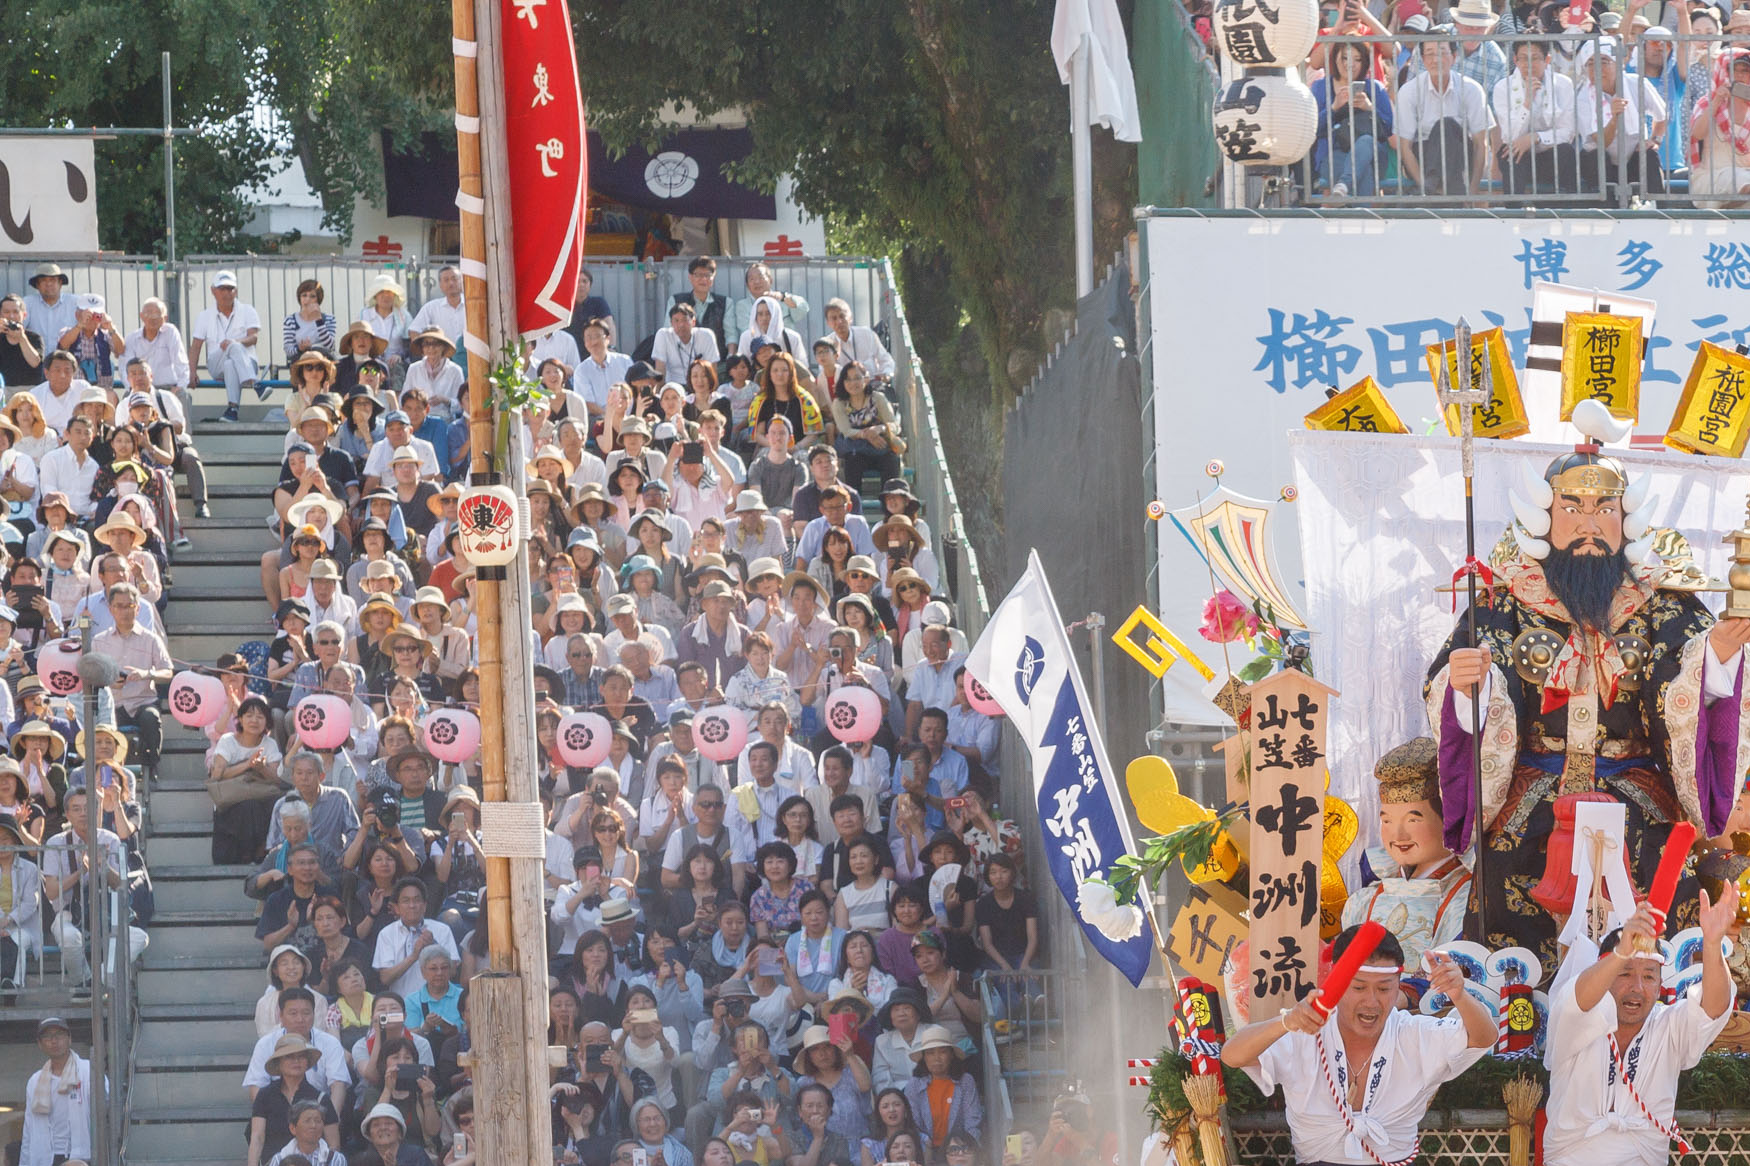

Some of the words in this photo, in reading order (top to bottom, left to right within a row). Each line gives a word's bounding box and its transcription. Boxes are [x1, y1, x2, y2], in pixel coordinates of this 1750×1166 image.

[1214, 77, 1271, 162] 山笠
[1583, 325, 1622, 408] 櫛田宮
[1698, 364, 1746, 446] 祇園宮
[472, 503, 497, 531] 東
[1065, 715, 1099, 794] 七番山笠
[1255, 694, 1294, 772] 山笠
[1290, 693, 1326, 769] 七番
[1252, 782, 1321, 1002] 中洲流
